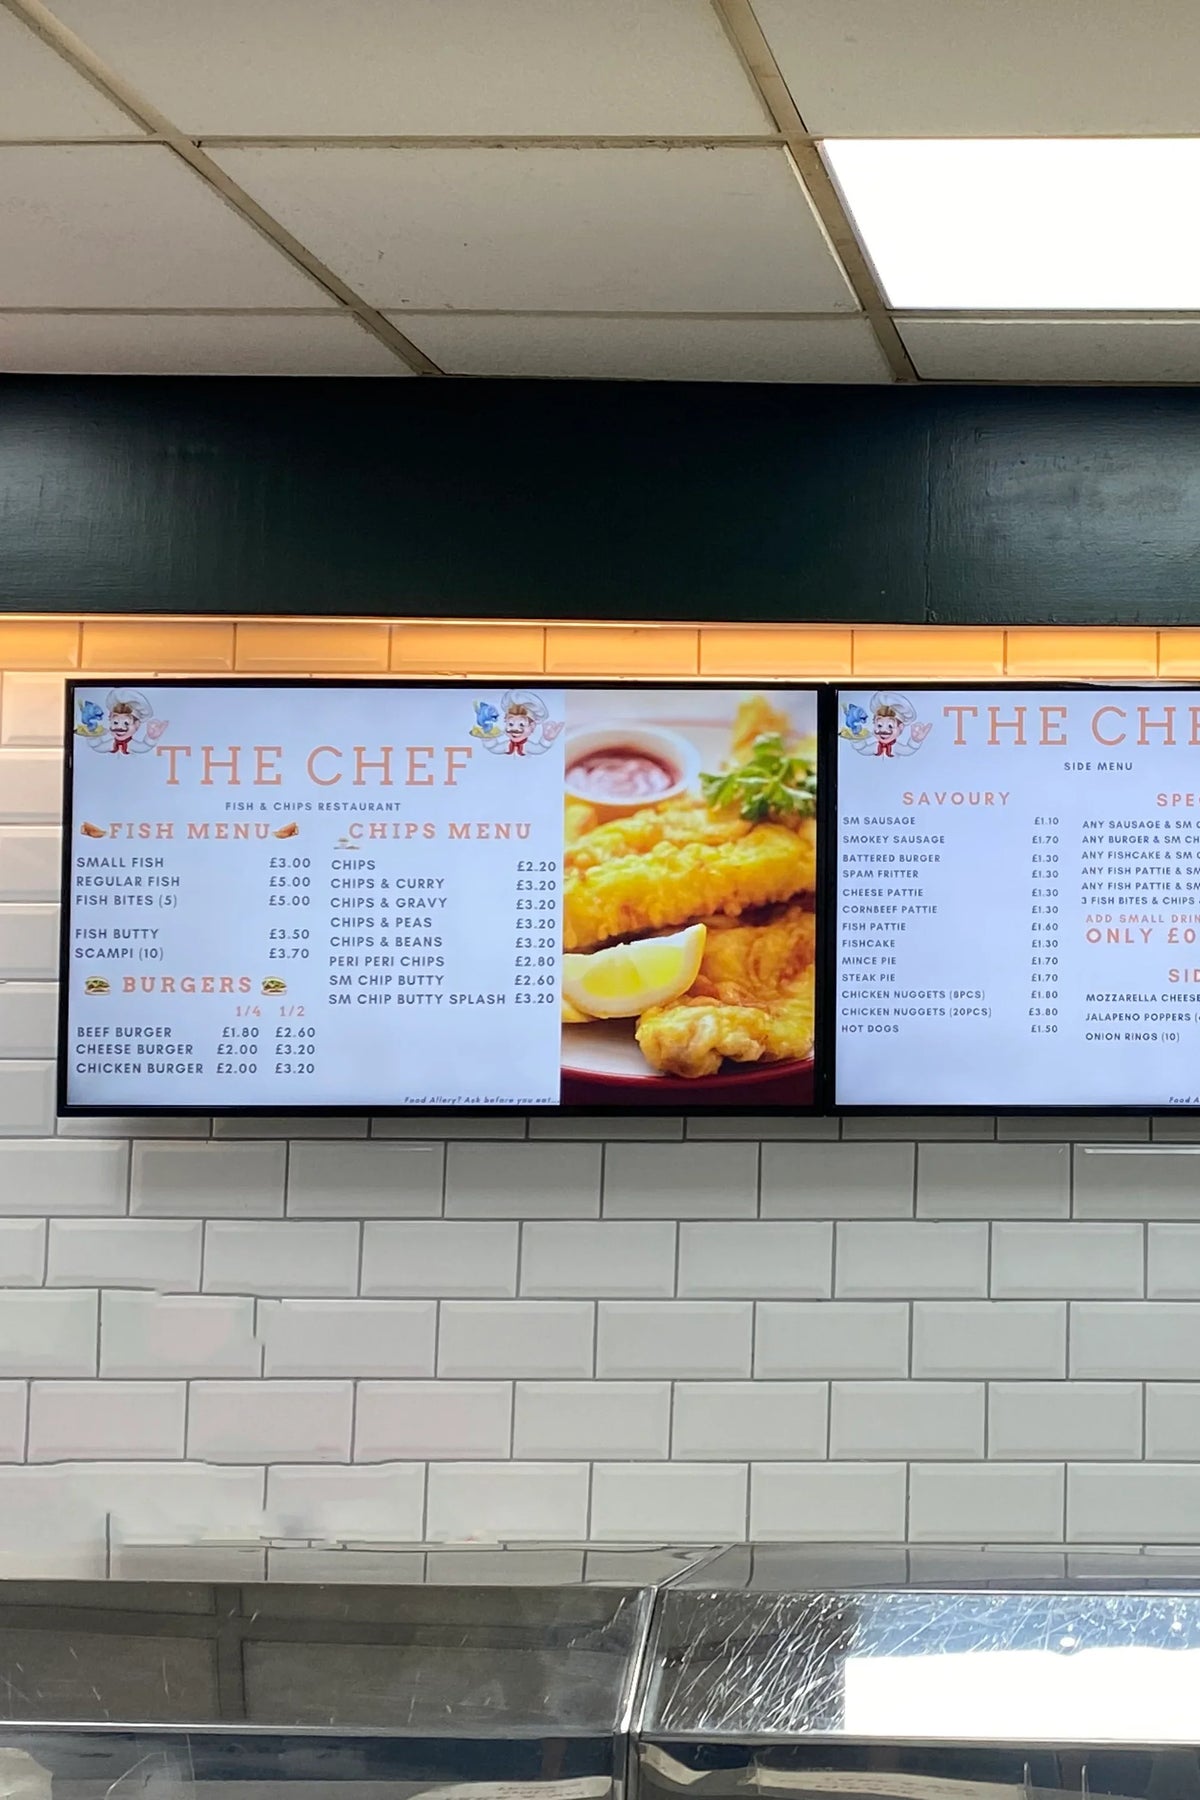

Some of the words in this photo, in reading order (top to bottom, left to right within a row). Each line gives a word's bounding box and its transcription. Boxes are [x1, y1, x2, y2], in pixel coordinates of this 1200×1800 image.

[943, 706, 1067, 745] THE
[156, 745, 282, 785] THE
[307, 746, 472, 786] CHEF
[1064, 762, 1091, 771] SIDE
[1097, 762, 1132, 771] MENU
[902, 792, 1009, 805] SAVOURY
[225, 802, 254, 811] FISH
[260, 803, 267, 811] &
[273, 802, 312, 811] CHIPS
[318, 802, 401, 811] RESTAURANT
[843, 817, 860, 825] SM
[864, 817, 915, 825] SAUSAGE
[1034, 816, 1059, 825] £1.10
[1082, 820, 1104, 829] ANY
[1109, 820, 1160, 829] SAUSAGE
[1164, 820, 1171, 829] &
[1176, 820, 1192, 829] SM
[110, 823, 174, 839] FISH
[187, 823, 270, 839] MENU
[349, 823, 435, 839] CHIPS
[448, 823, 531, 839] MENU
[843, 835, 889, 843] SMOKEY
[893, 835, 944, 844] SAUSAGE
[1032, 835, 1059, 844] £1.70
[77, 857, 126, 868] SMALL
[132, 857, 163, 868] FISH
[269, 857, 311, 868] £3.00
[843, 854, 895, 862] BATTERED
[899, 854, 940, 862] BURGER
[1032, 854, 1059, 863] £1.30
[76, 876, 142, 886] REGULAR
[148, 876, 179, 887] FISH
[269, 876, 310, 887] £5.00
[331, 878, 374, 889] CHIPS
[381, 878, 390, 889] &
[396, 878, 445, 889] CURRY
[516, 880, 556, 891] £3.20
[1085, 914, 1112, 923] ADD
[1119, 914, 1164, 923] SMALL
[75, 928, 107, 939] FISH
[113, 928, 159, 939] BUTTY
[269, 929, 309, 940] £3.50
[1086, 928, 1153, 944] ONLY
[842, 939, 895, 948] FISHCAKE
[1032, 939, 1058, 948] £1.30
[75, 948, 133, 958] SCAMPI
[139, 948, 163, 961] (10)
[269, 948, 309, 959] £3.70
[329, 956, 358, 967] PERI
[365, 956, 394, 967] PERI
[400, 956, 445, 967] CHIPS
[515, 956, 555, 967] £2.80
[329, 975, 352, 986] SM
[358, 975, 392, 985] CHIP
[398, 975, 444, 986] BUTTY
[514, 975, 555, 986] £2.60
[842, 973, 876, 982] STEAK
[880, 973, 895, 982] PIE
[1031, 973, 1058, 982] £1.70
[122, 976, 251, 993] BURGERS
[1086, 994, 1157, 1002] MOZZARELLA
[1161, 994, 1200, 1002] CHEESE
[236, 1005, 261, 1017] 1/4
[280, 1005, 305, 1017] 1/2
[77, 1027, 109, 1037] BEEF
[116, 1027, 171, 1037] BURGER
[222, 1027, 259, 1038] £1.80
[275, 1027, 315, 1038] £2.60
[76, 1063, 141, 1073] CHICKEN
[147, 1063, 203, 1073] BURGER
[216, 1063, 257, 1074] £2.00
[275, 1063, 315, 1074] £3.20
